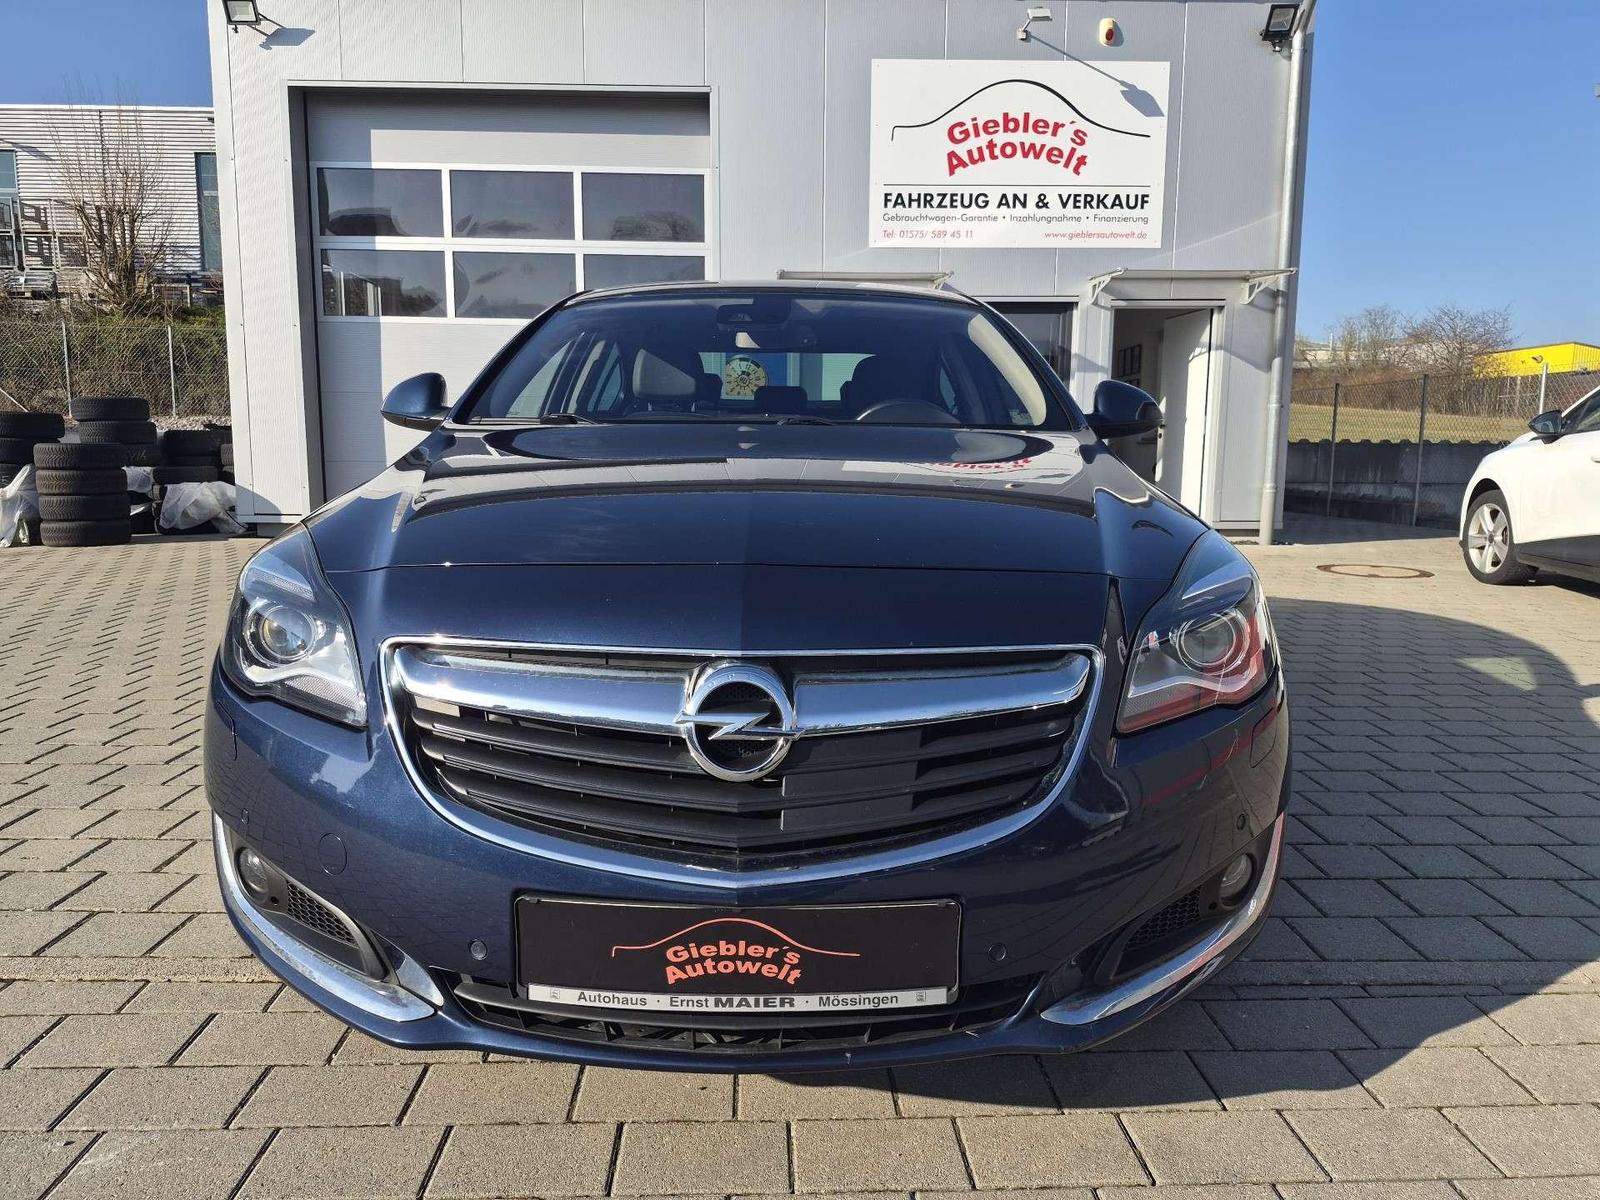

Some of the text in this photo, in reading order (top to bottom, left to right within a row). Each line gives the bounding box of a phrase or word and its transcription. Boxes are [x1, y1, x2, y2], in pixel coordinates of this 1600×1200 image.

[945, 138, 1088, 176] Autowelt
[883, 192, 1150, 210] FAHRZEUG AN & VERKAUF
[882, 213, 1149, 225] Gebrauchtwagen-Garantie Inzahlungnahme Finanzierung
[931, 230, 947, 239] 589
[950, 230, 961, 239] 45
[965, 230, 973, 239] 11
[1044, 230, 1148, 241] www.gieblersautowelt.de
[665, 957, 802, 985] Autowelt
[577, 991, 898, 1009] Autohaus Ernst MAIER Mössingen
